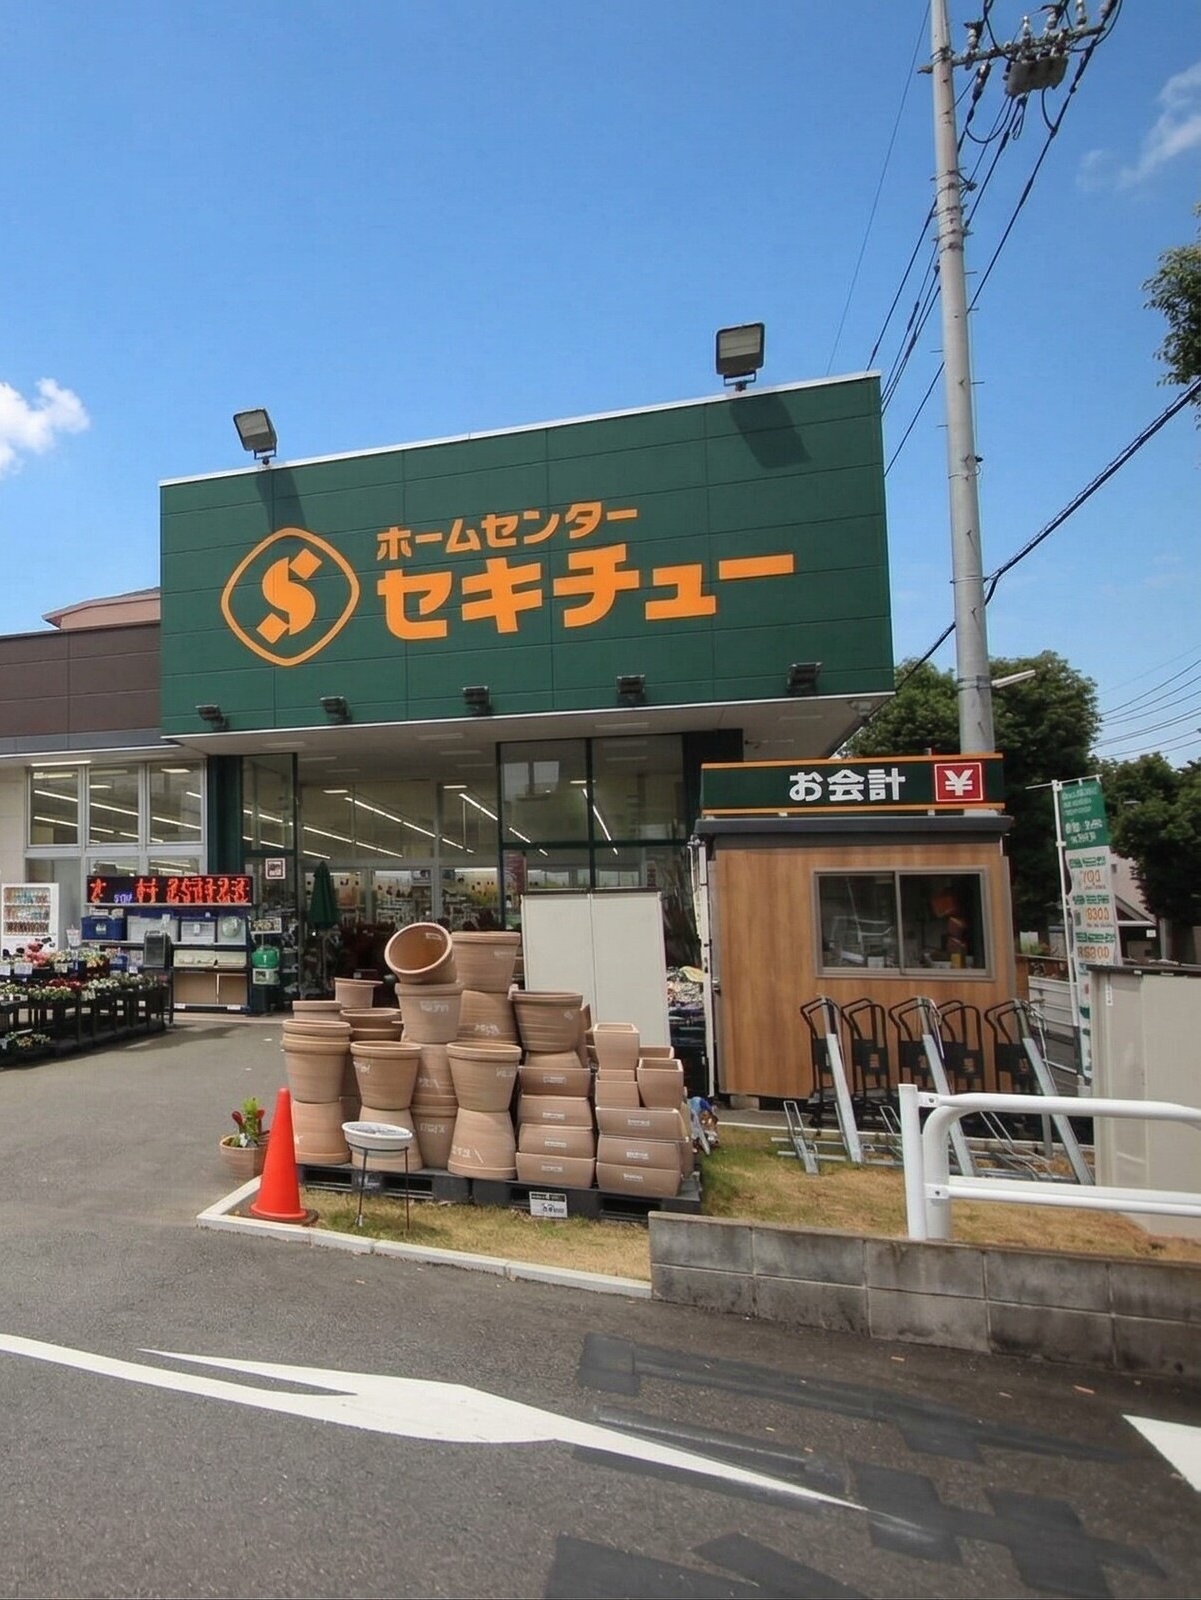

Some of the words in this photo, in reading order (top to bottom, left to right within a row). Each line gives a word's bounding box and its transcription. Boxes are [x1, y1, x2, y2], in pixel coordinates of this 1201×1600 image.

[377, 502, 638, 560] ホームセンター
[377, 543, 795, 640] セキチュー
[788, 767, 907, 802] お会計
